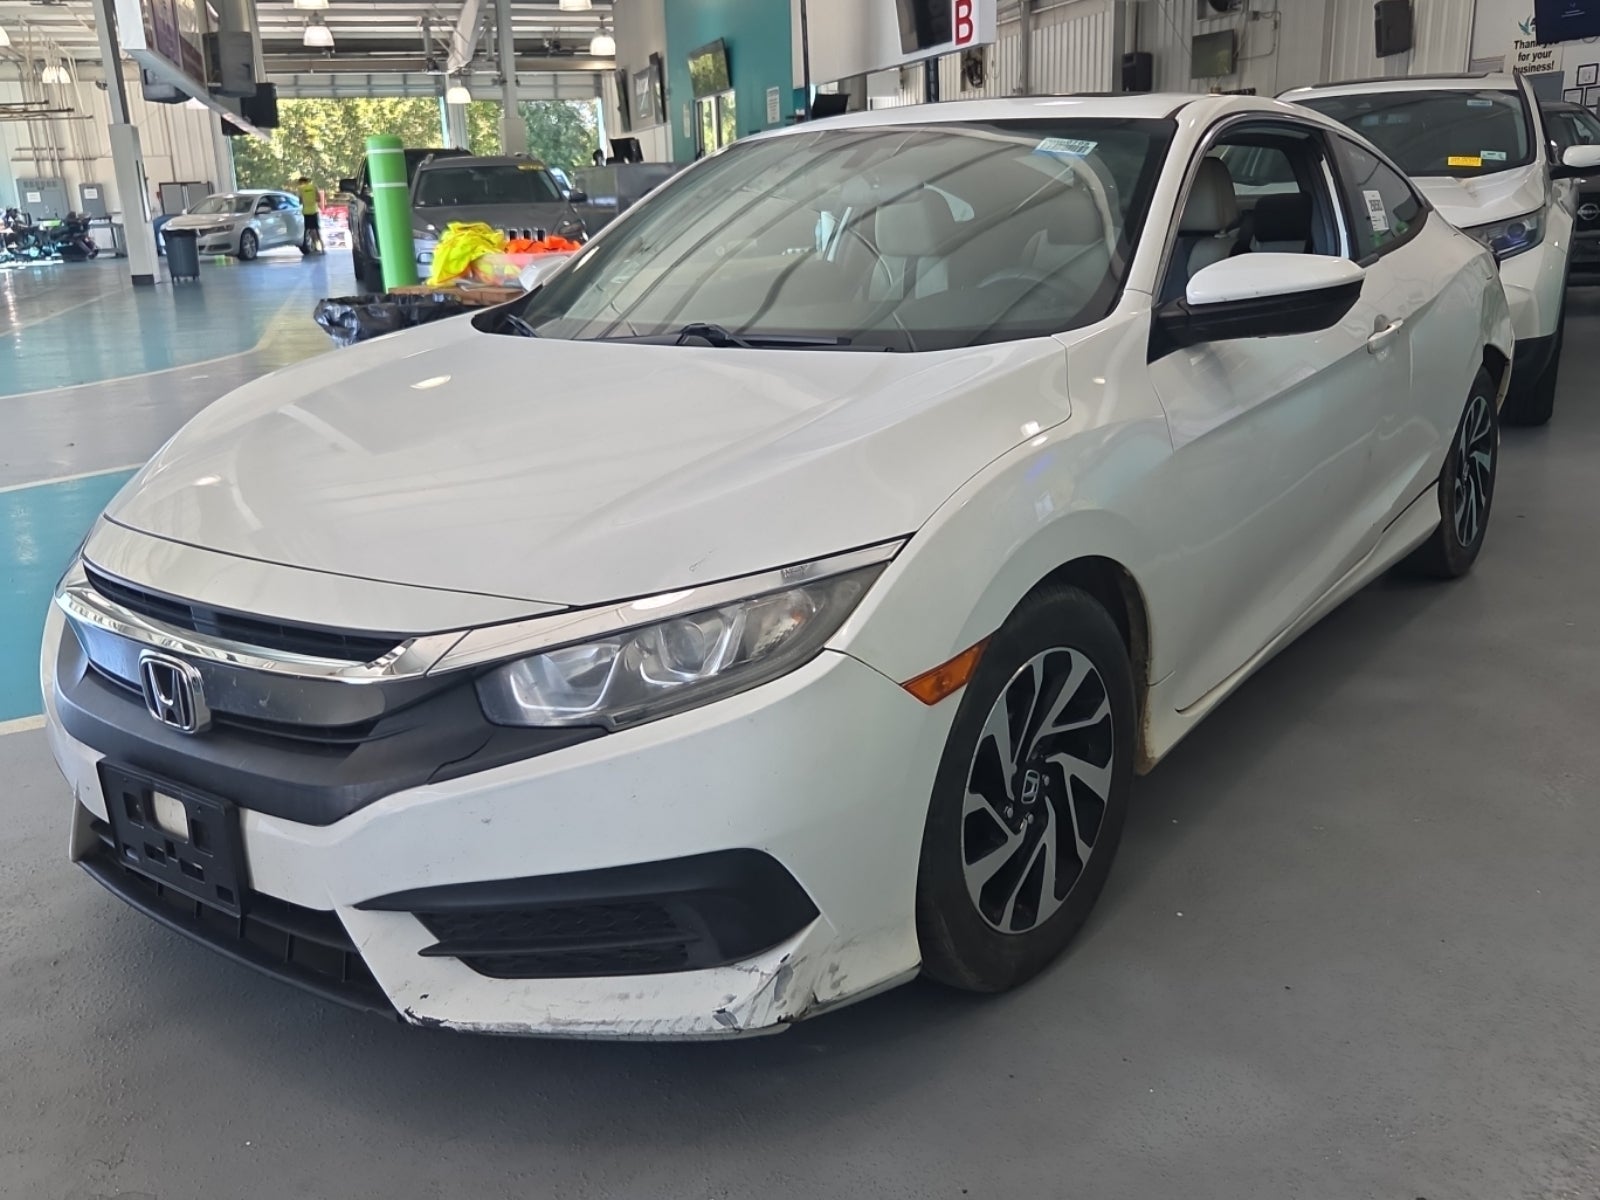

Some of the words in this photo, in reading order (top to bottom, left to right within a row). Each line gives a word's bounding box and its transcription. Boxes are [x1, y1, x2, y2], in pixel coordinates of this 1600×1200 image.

[955, 0, 974, 45] B
[1518, 52, 1531, 62] for
[1532, 50, 1553, 62] your
[1513, 60, 1554, 73] business!
